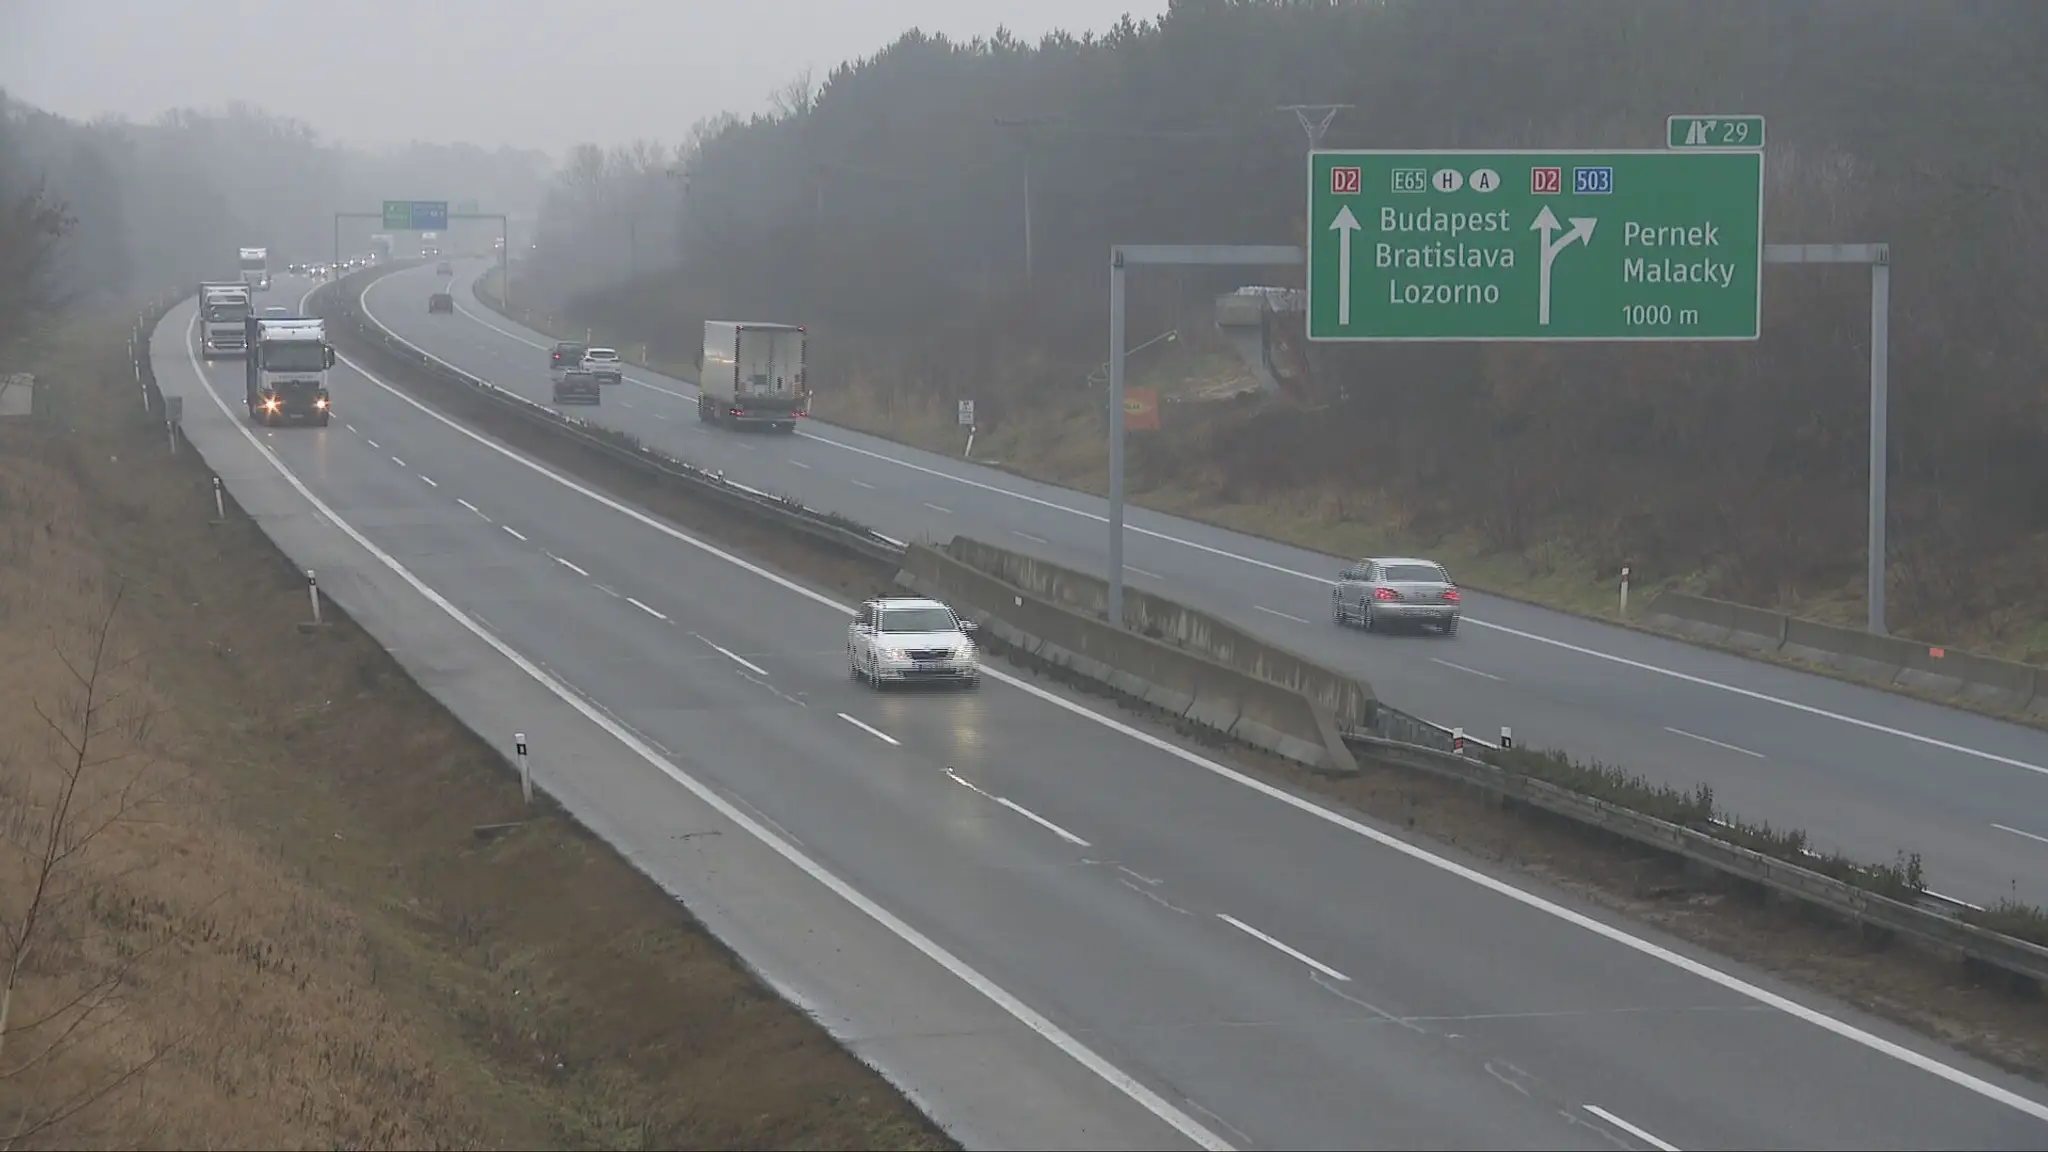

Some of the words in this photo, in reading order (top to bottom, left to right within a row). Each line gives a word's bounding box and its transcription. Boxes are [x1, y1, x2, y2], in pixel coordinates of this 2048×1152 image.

[1723, 122, 1749, 143] 29
[1333, 171, 1359, 192] D2
[1394, 172, 1425, 192] E65
[1442, 172, 1453, 190] H
[1479, 172, 1491, 190] A
[1533, 171, 1560, 192] D2
[1575, 171, 1610, 192] 503
[1380, 206, 1511, 237] Budapest
[1624, 221, 1720, 247] Pernek
[1376, 241, 1515, 269] Bratislava
[1624, 257, 1736, 288] Malacky
[1390, 279, 1500, 304] Lozorno
[1622, 304, 1672, 326] 1000
[1679, 308, 1699, 326] m
